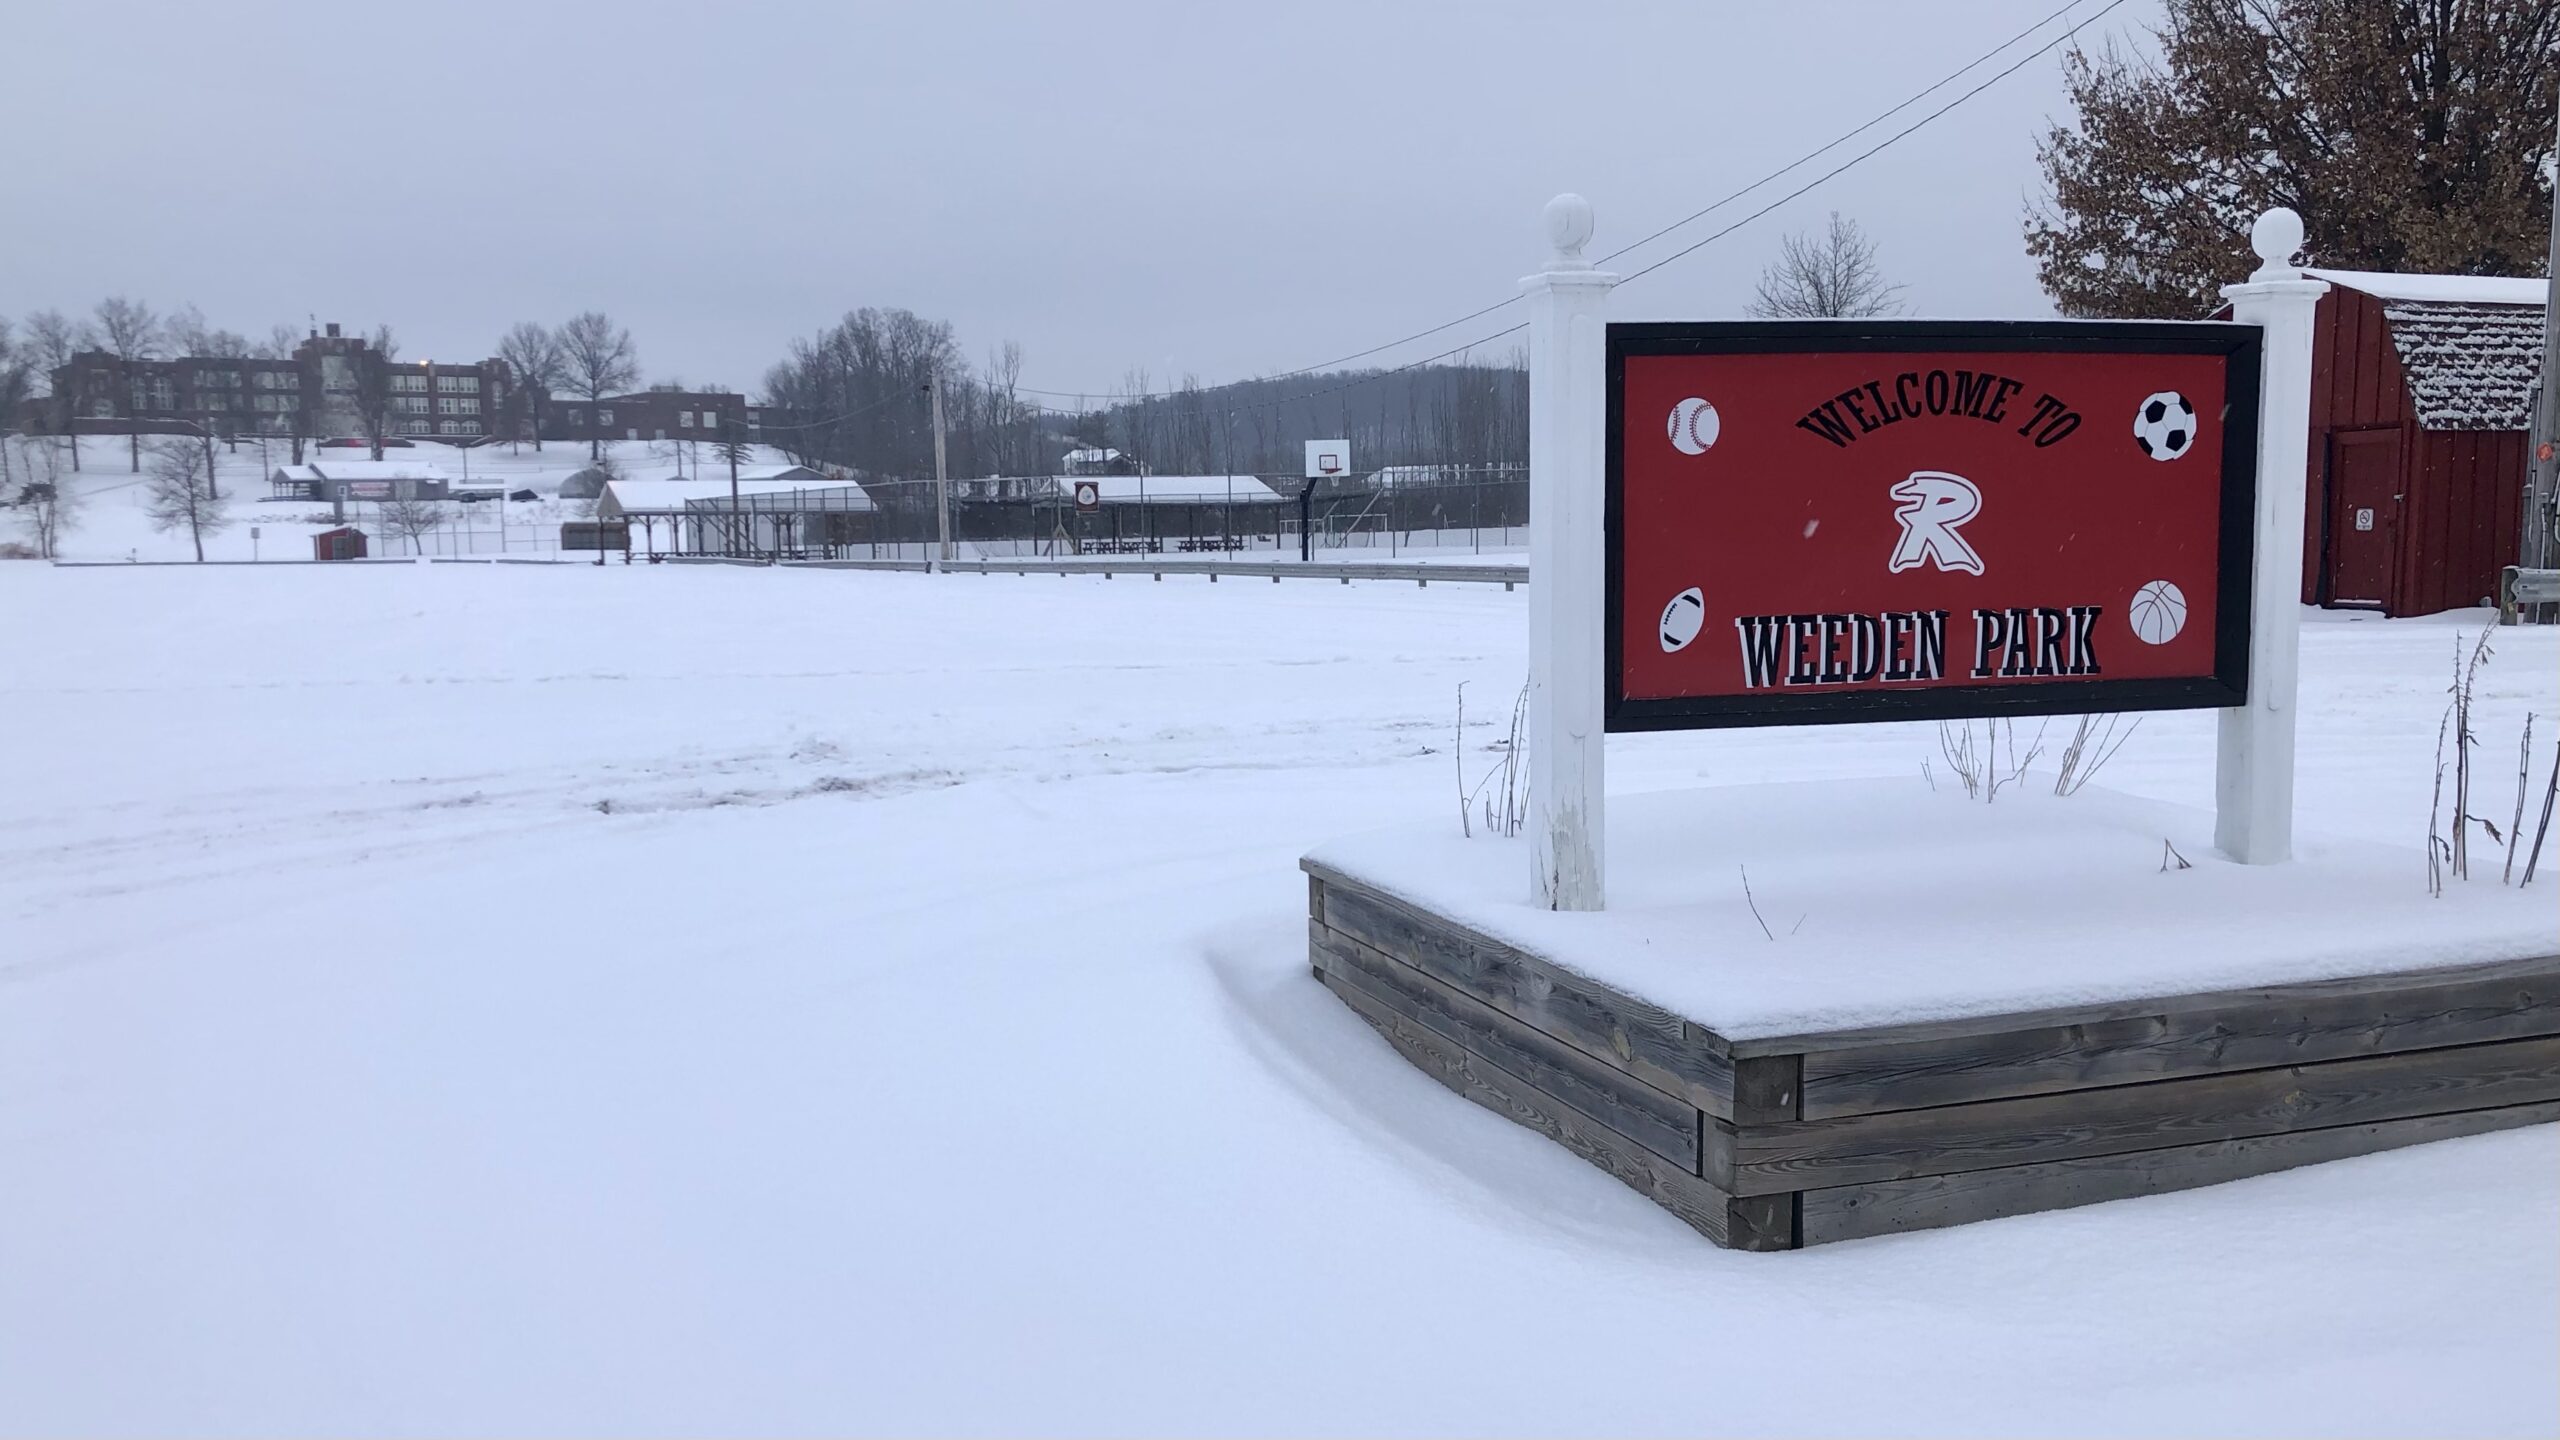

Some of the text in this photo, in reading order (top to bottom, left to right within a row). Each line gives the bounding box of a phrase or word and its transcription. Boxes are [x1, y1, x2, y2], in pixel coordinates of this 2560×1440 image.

[1796, 370, 2081, 448] WELCOME TO
[1889, 471, 1985, 576] R
[1735, 606, 2102, 688] WEEDEN PARK
